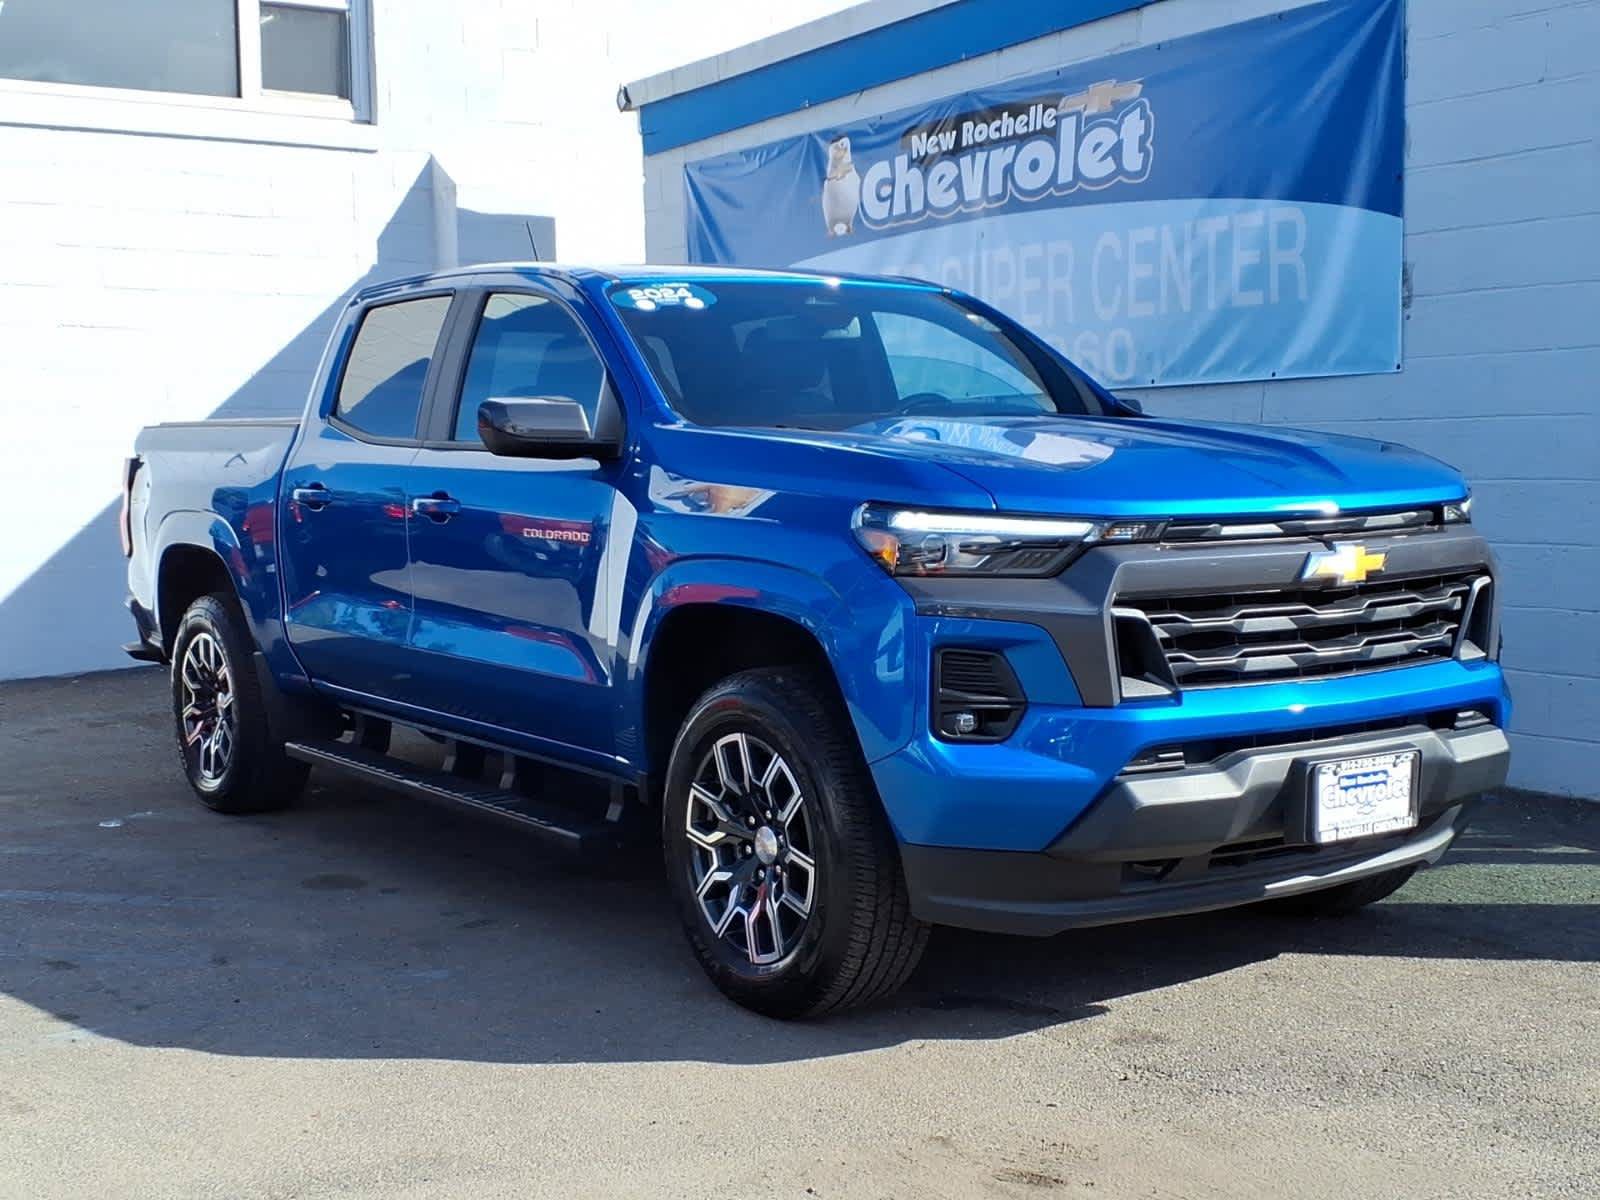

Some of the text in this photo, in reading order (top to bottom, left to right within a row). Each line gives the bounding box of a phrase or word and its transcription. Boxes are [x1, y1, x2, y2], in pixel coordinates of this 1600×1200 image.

[862, 107, 1146, 220] Chevrolet
[911, 104, 1057, 159] New Rochelle
[1091, 207, 1307, 322] CENTER
[522, 528, 592, 542] COLORADO
